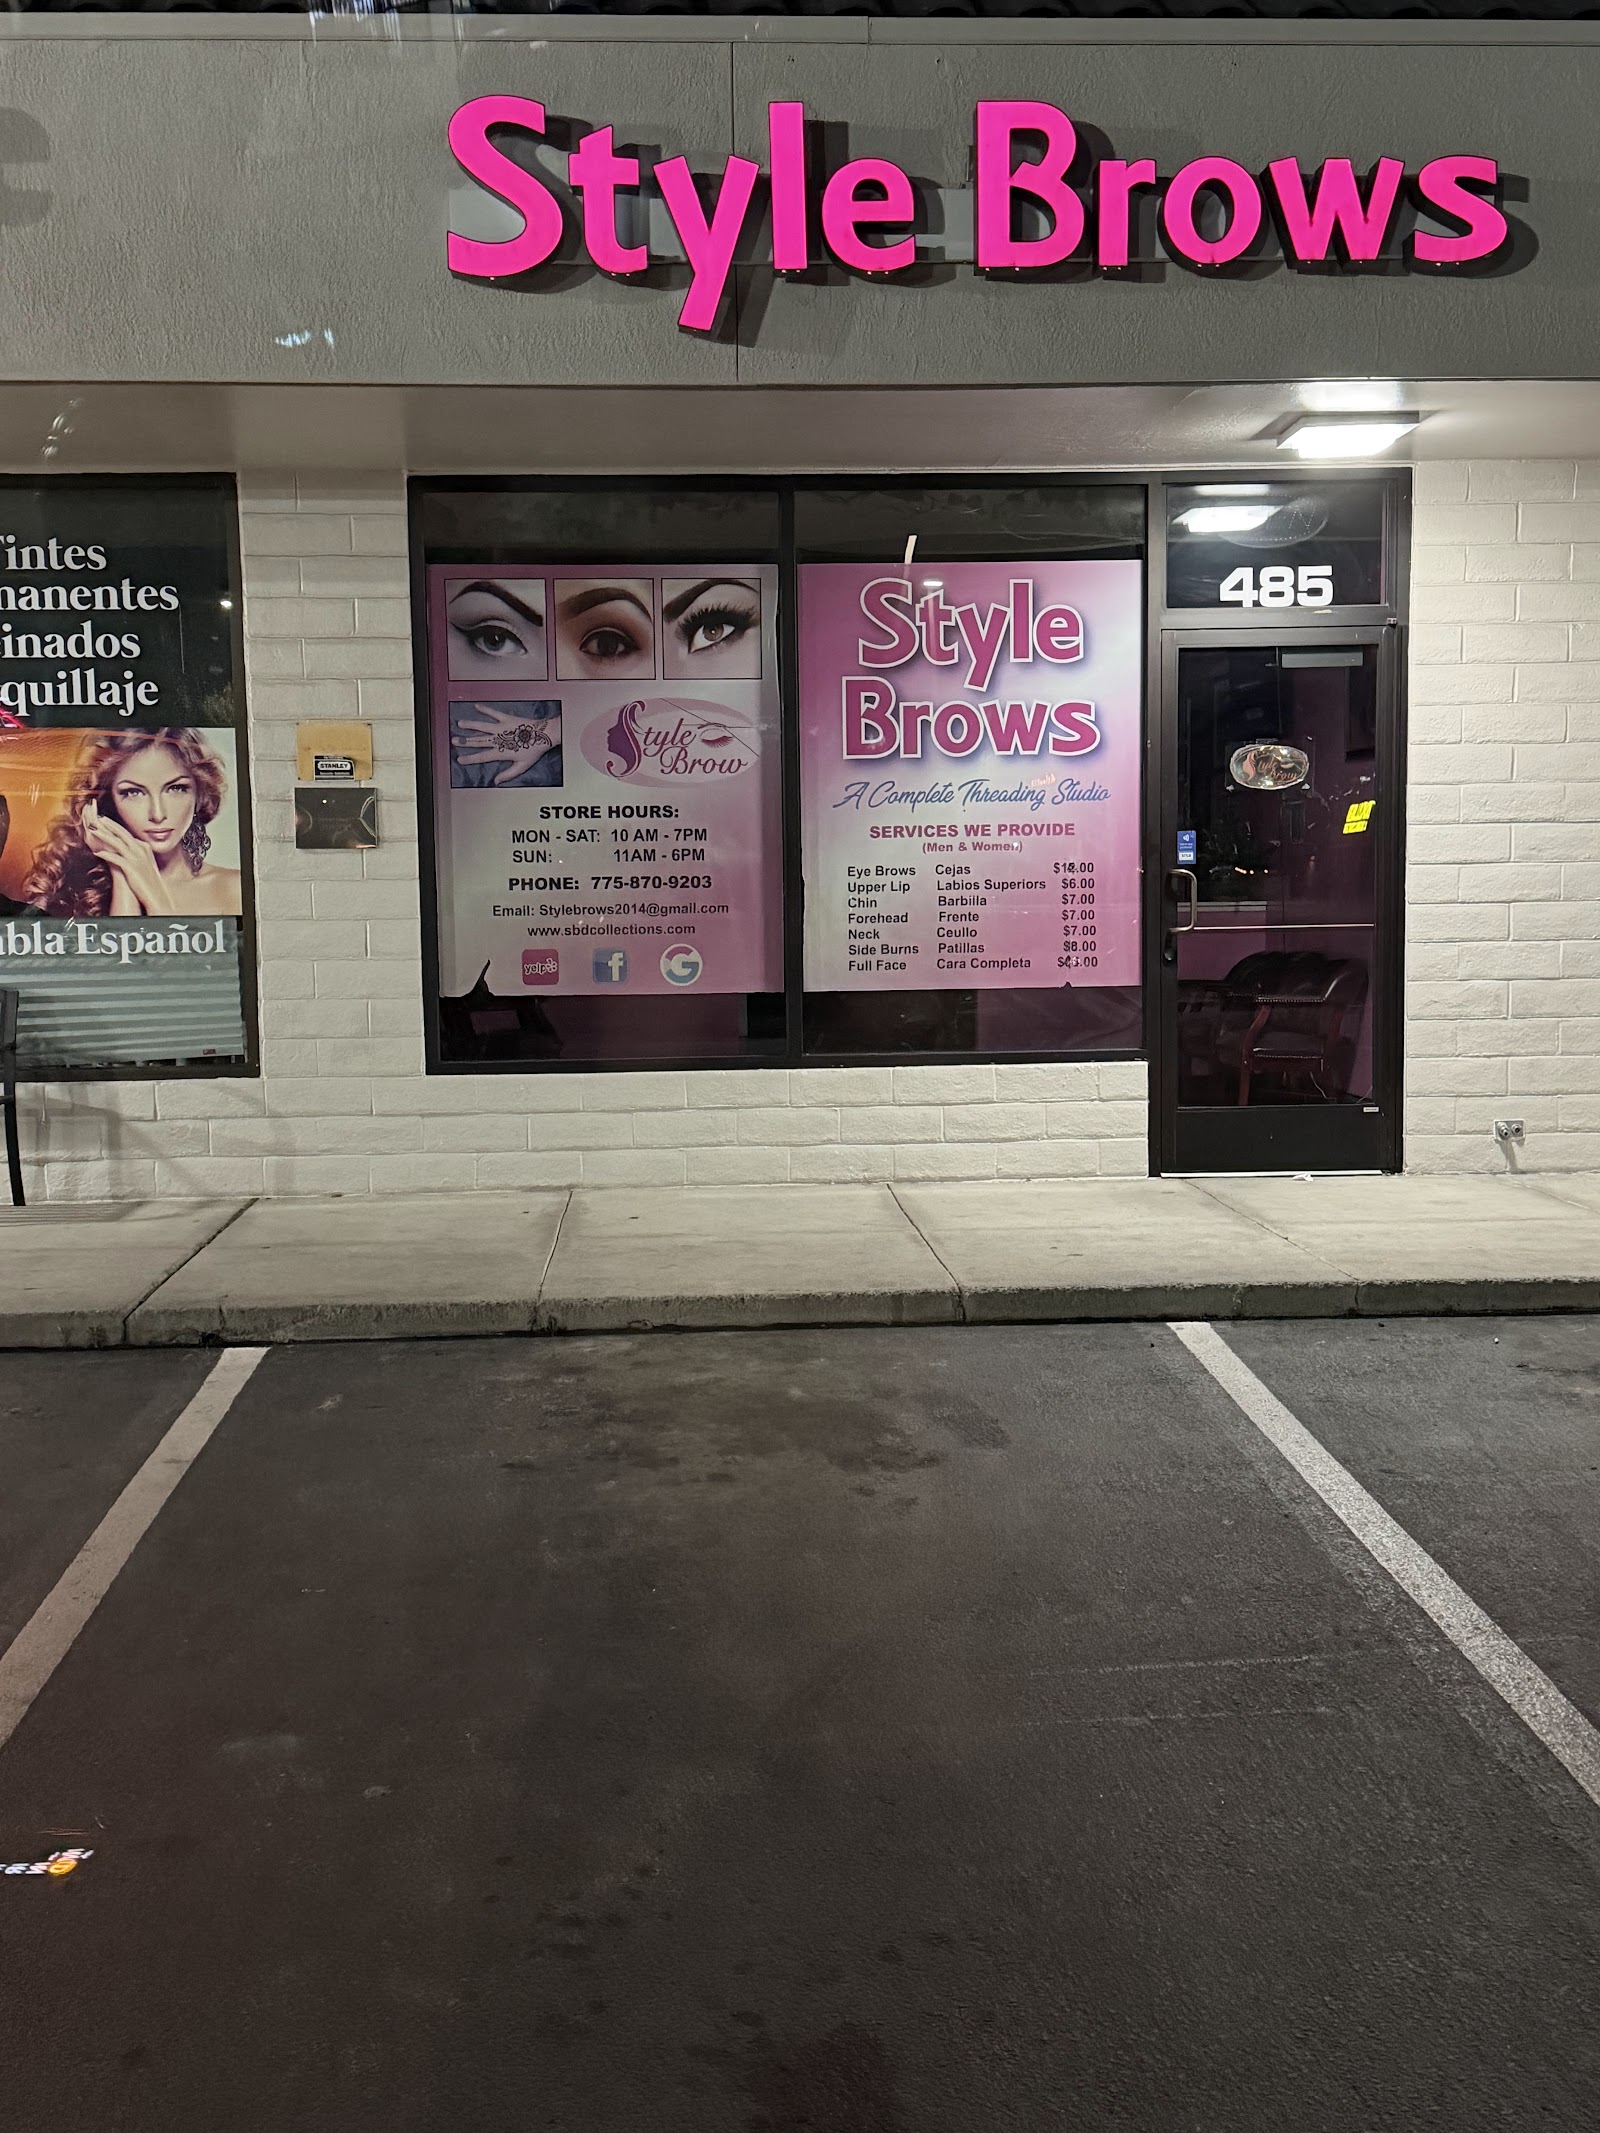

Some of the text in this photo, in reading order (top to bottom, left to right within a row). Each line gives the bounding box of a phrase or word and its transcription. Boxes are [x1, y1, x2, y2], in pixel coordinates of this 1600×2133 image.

[447, 95, 1509, 331] Style Brows
[0, 534, 107, 571] intes
[1219, 565, 1333, 608] 485
[0, 620, 141, 659] inados
[858, 578, 1084, 691] Style
[0, 667, 159, 717] quillaje
[842, 676, 1101, 760] Brows
[606, 700, 697, 777] Style
[660, 746, 748, 775] Brow
[832, 781, 870, 809] A
[867, 780, 954, 813] Complete
[957, 778, 1046, 811] Threading
[1051, 778, 1111, 805] Studio
[539, 805, 679, 819] STORE HOURS:
[512, 830, 550, 843] MON
[566, 829, 600, 842] SAT:
[611, 829, 629, 842] 10
[633, 829, 659, 842] AM
[674, 828, 707, 841] 7PM
[869, 823, 1075, 839] SERVICES WE PROVIDE
[512, 850, 552, 863] SUN:
[614, 849, 656, 862] 11AM
[672, 848, 705, 861] 6PM
[922, 842, 953, 854] (Men
[958, 842, 968, 852] &
[847, 866, 871, 879] Eye
[875, 865, 916, 877] Brows
[935, 864, 971, 877] Cejas
[508, 875, 712, 890] PHONE: 775-870-9203
[847, 878, 1095, 895] Upper Lip Labios Superiors $6.00
[848, 893, 1095, 908] Chin Barbilla $7.00
[492, 903, 729, 918] Email: Stylebrows2014@gmail.com
[848, 909, 1095, 924] Forehead Frente $7.00
[527, 924, 696, 936] www.sbdcollections.com
[848, 925, 1097, 940] Neck Ceullo $7.00
[0, 919, 226, 964] bla Español
[848, 940, 1097, 956] Side Burns Patillas $8.00
[523, 961, 547, 975] yelp
[849, 960, 872, 971] Full
[876, 960, 907, 971] Face
[937, 958, 966, 969] Cara
[970, 957, 1031, 972] Completa
